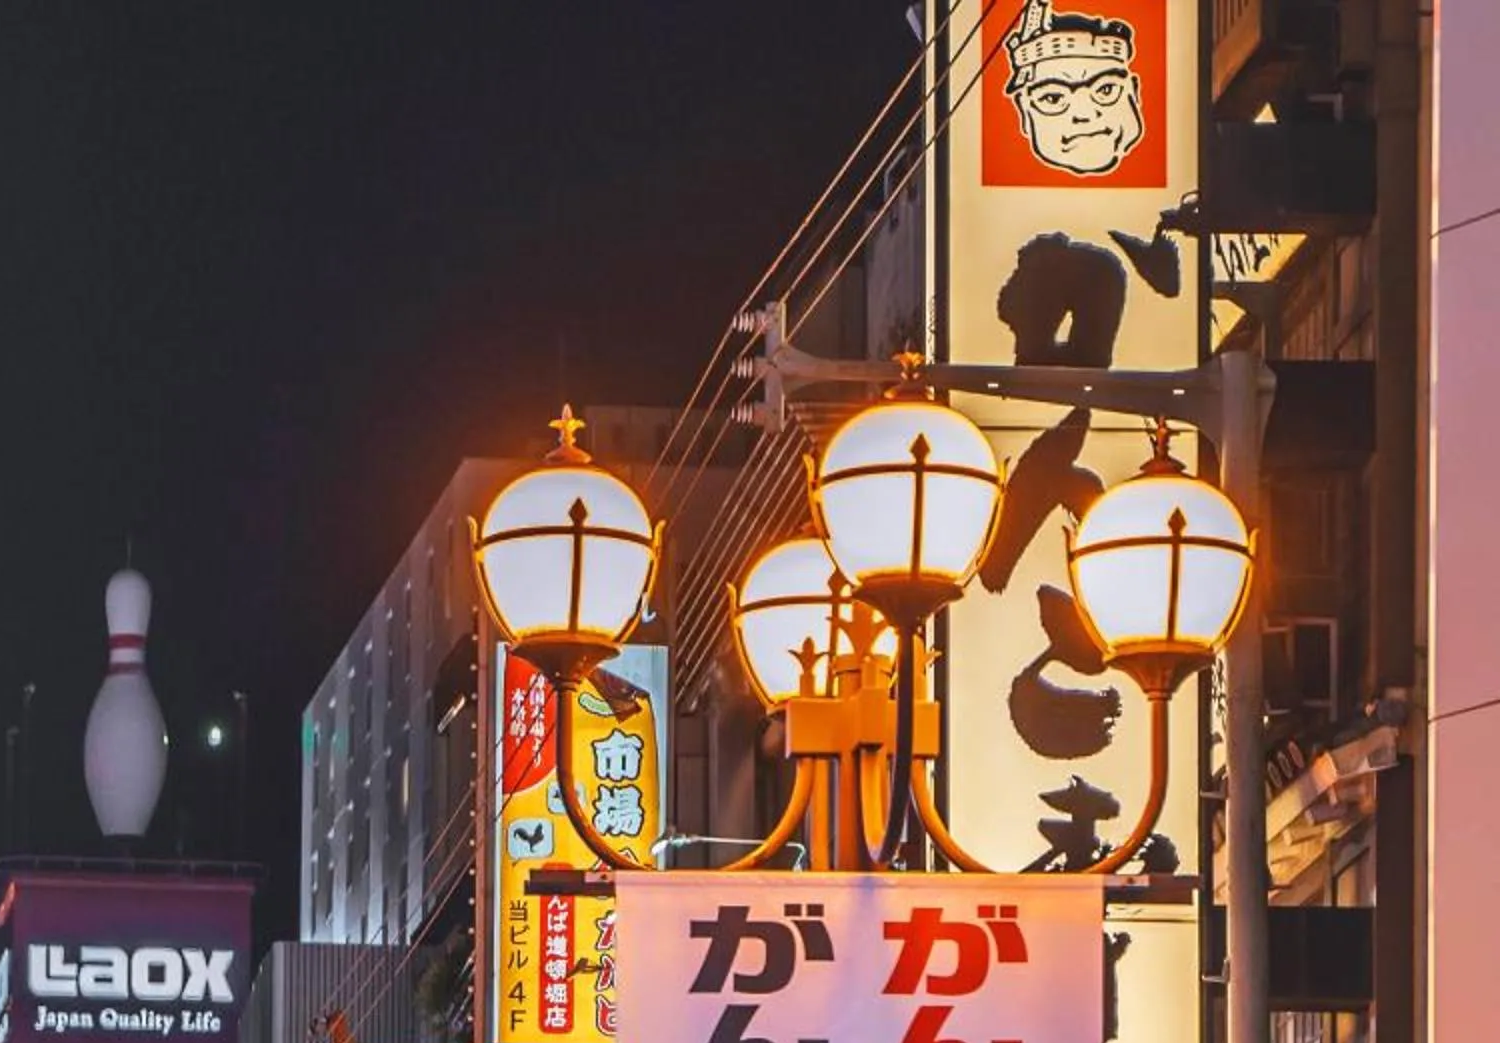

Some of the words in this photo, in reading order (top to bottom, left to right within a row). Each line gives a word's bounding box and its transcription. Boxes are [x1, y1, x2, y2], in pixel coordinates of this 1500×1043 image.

[591, 728, 646, 838] 市場
[545, 895, 568, 1028] んば道頓堀店
[34, 1005, 94, 1033] Japan
[100, 1007, 174, 1036] Quality
[181, 1009, 221, 1032] Life
